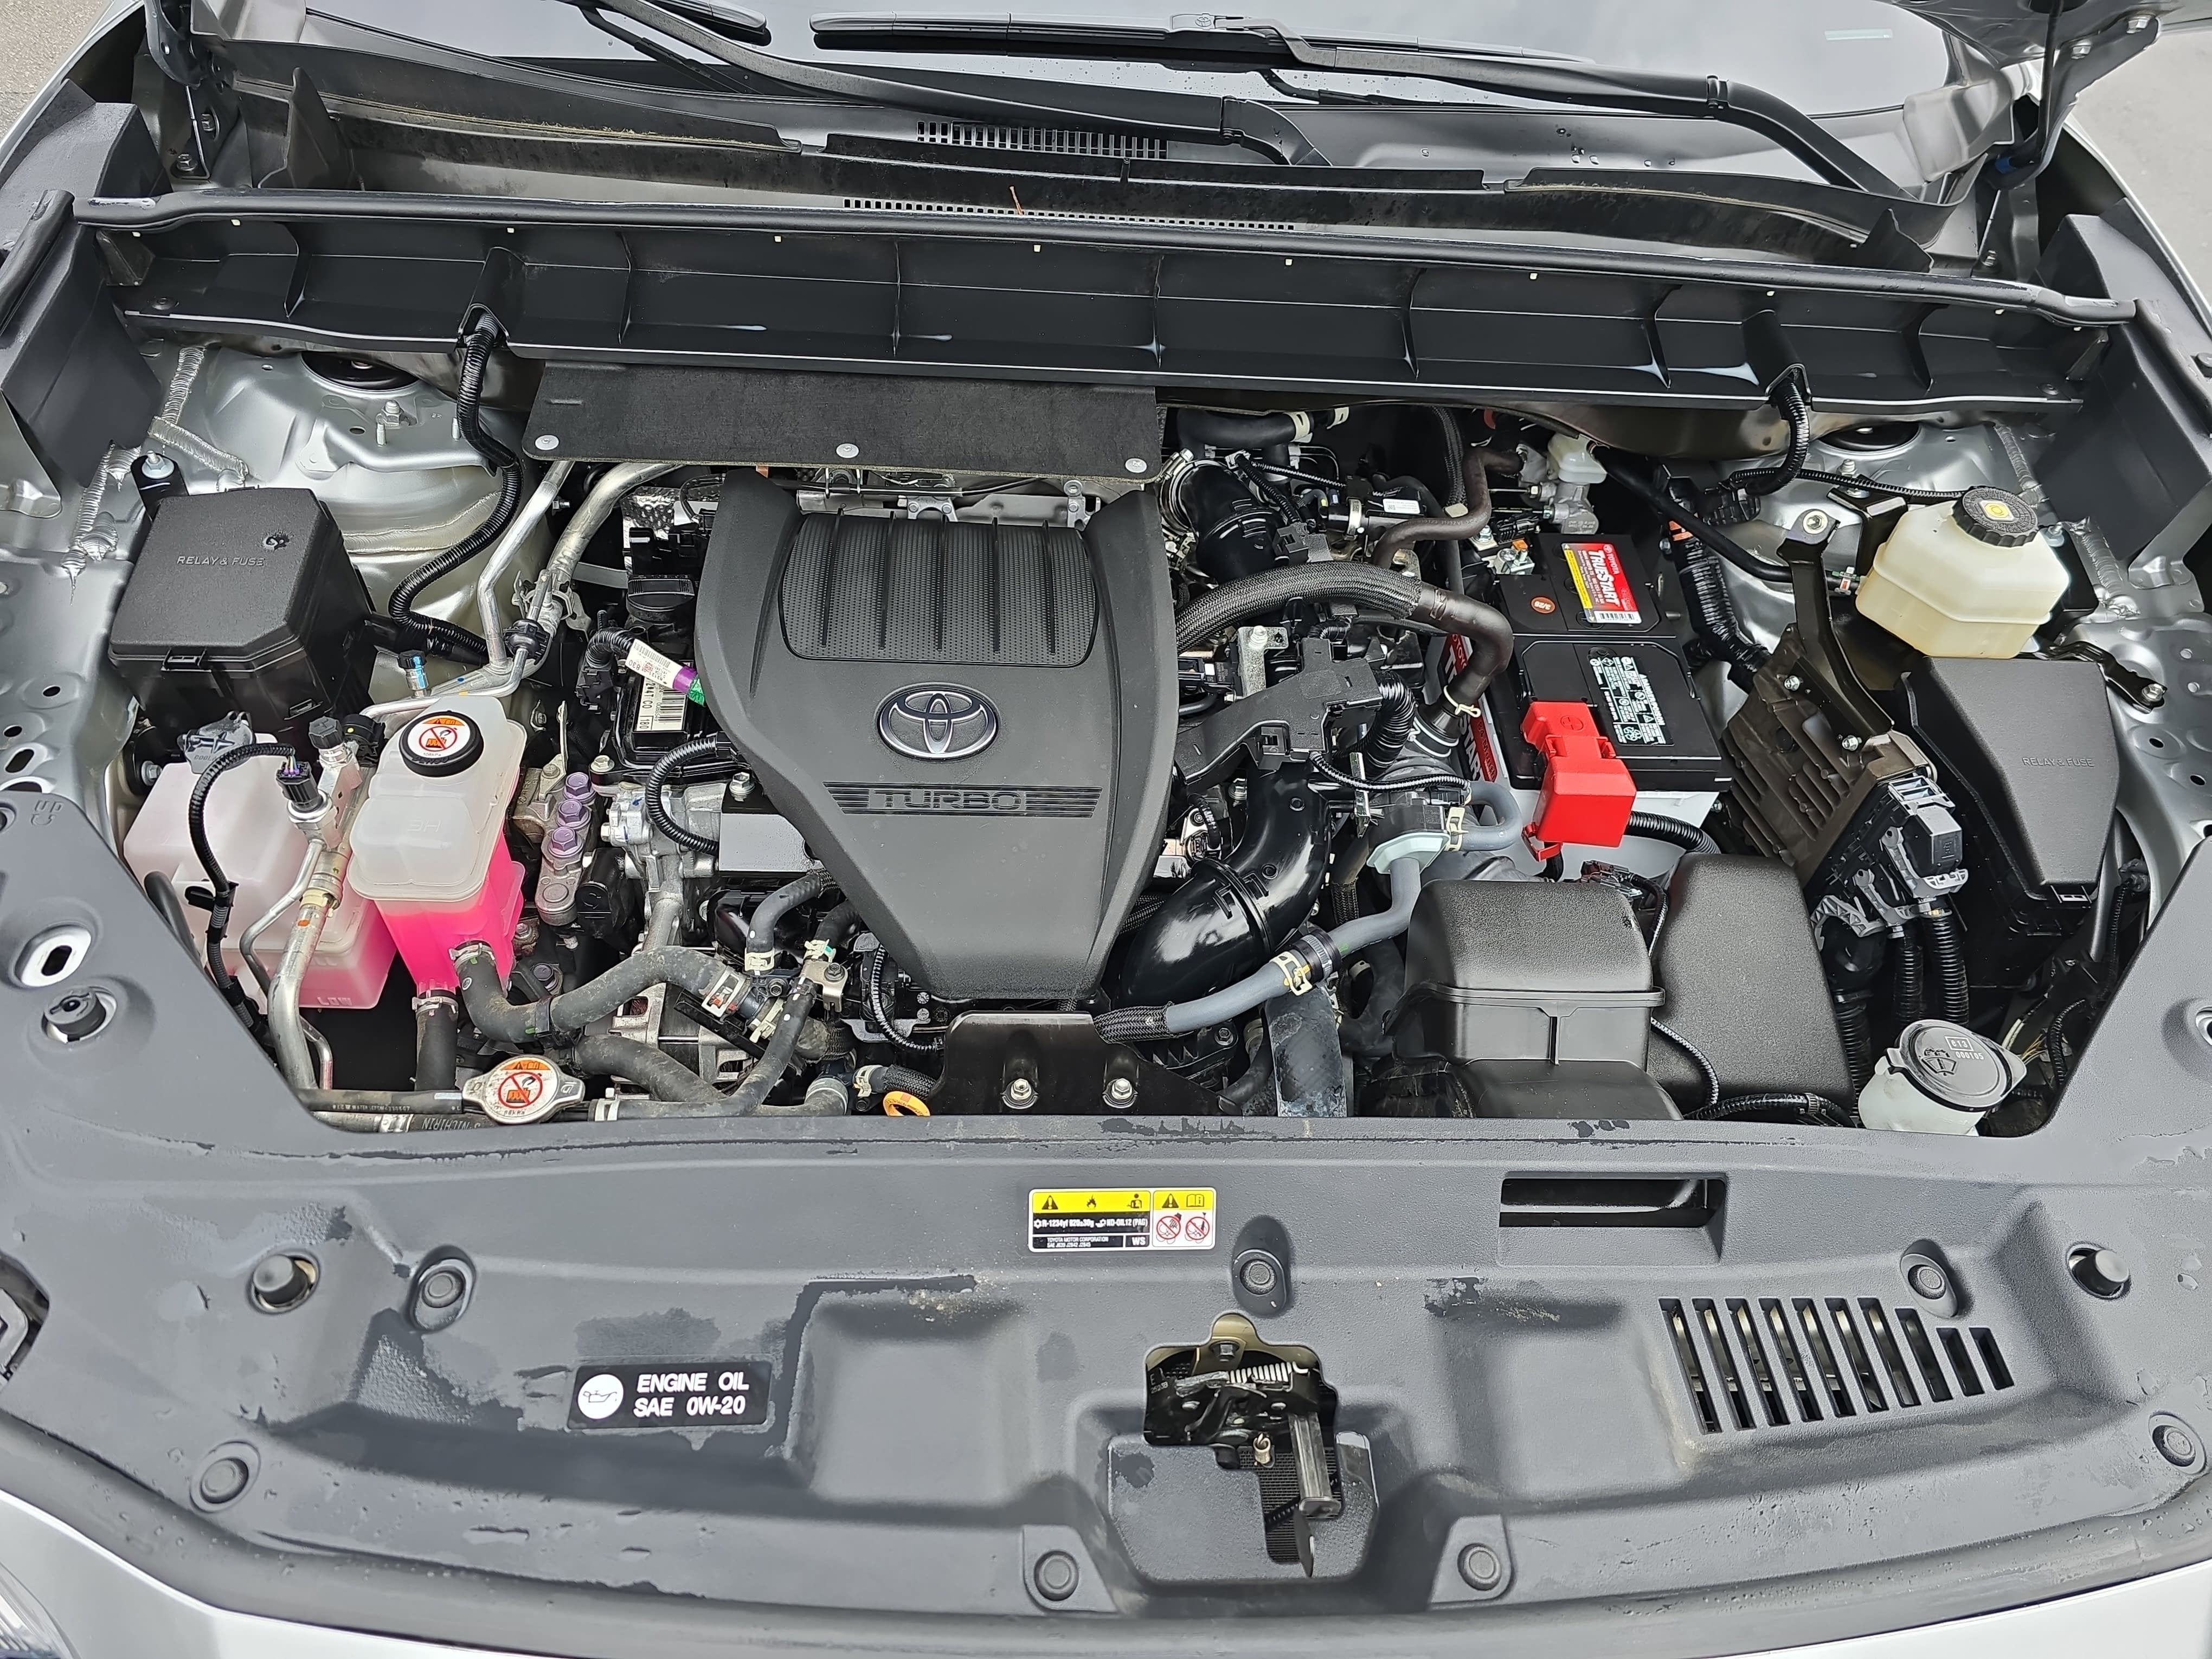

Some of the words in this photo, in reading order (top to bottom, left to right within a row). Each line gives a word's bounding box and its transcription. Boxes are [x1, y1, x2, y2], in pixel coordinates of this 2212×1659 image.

[177, 555, 220, 565] RELAY
[220, 557, 228, 566] &
[232, 557, 265, 567] FUSE
[1606, 554, 1619, 575] TOYOTA
[628, 659, 640, 671] 830
[639, 719, 650, 729] 180
[2022, 757, 2055, 767] RELAY
[2056, 758, 2064, 767] &
[2067, 758, 2094, 768] FUSE
[871, 789, 1021, 811] TURBO
[35, 800, 64, 813] UP
[317, 996, 352, 1006] LOW
[1951, 1039, 1968, 1047] e13
[1956, 1051, 1984, 1059] 000105
[1133, 1218, 1148, 1227] (PAG)
[1132, 1237, 1146, 1245] WS
[636, 1373, 708, 1393] ENGINE
[718, 1372, 749, 1391] OIL
[633, 1397, 674, 1418] SAE
[686, 1396, 746, 1416] 0W-20
